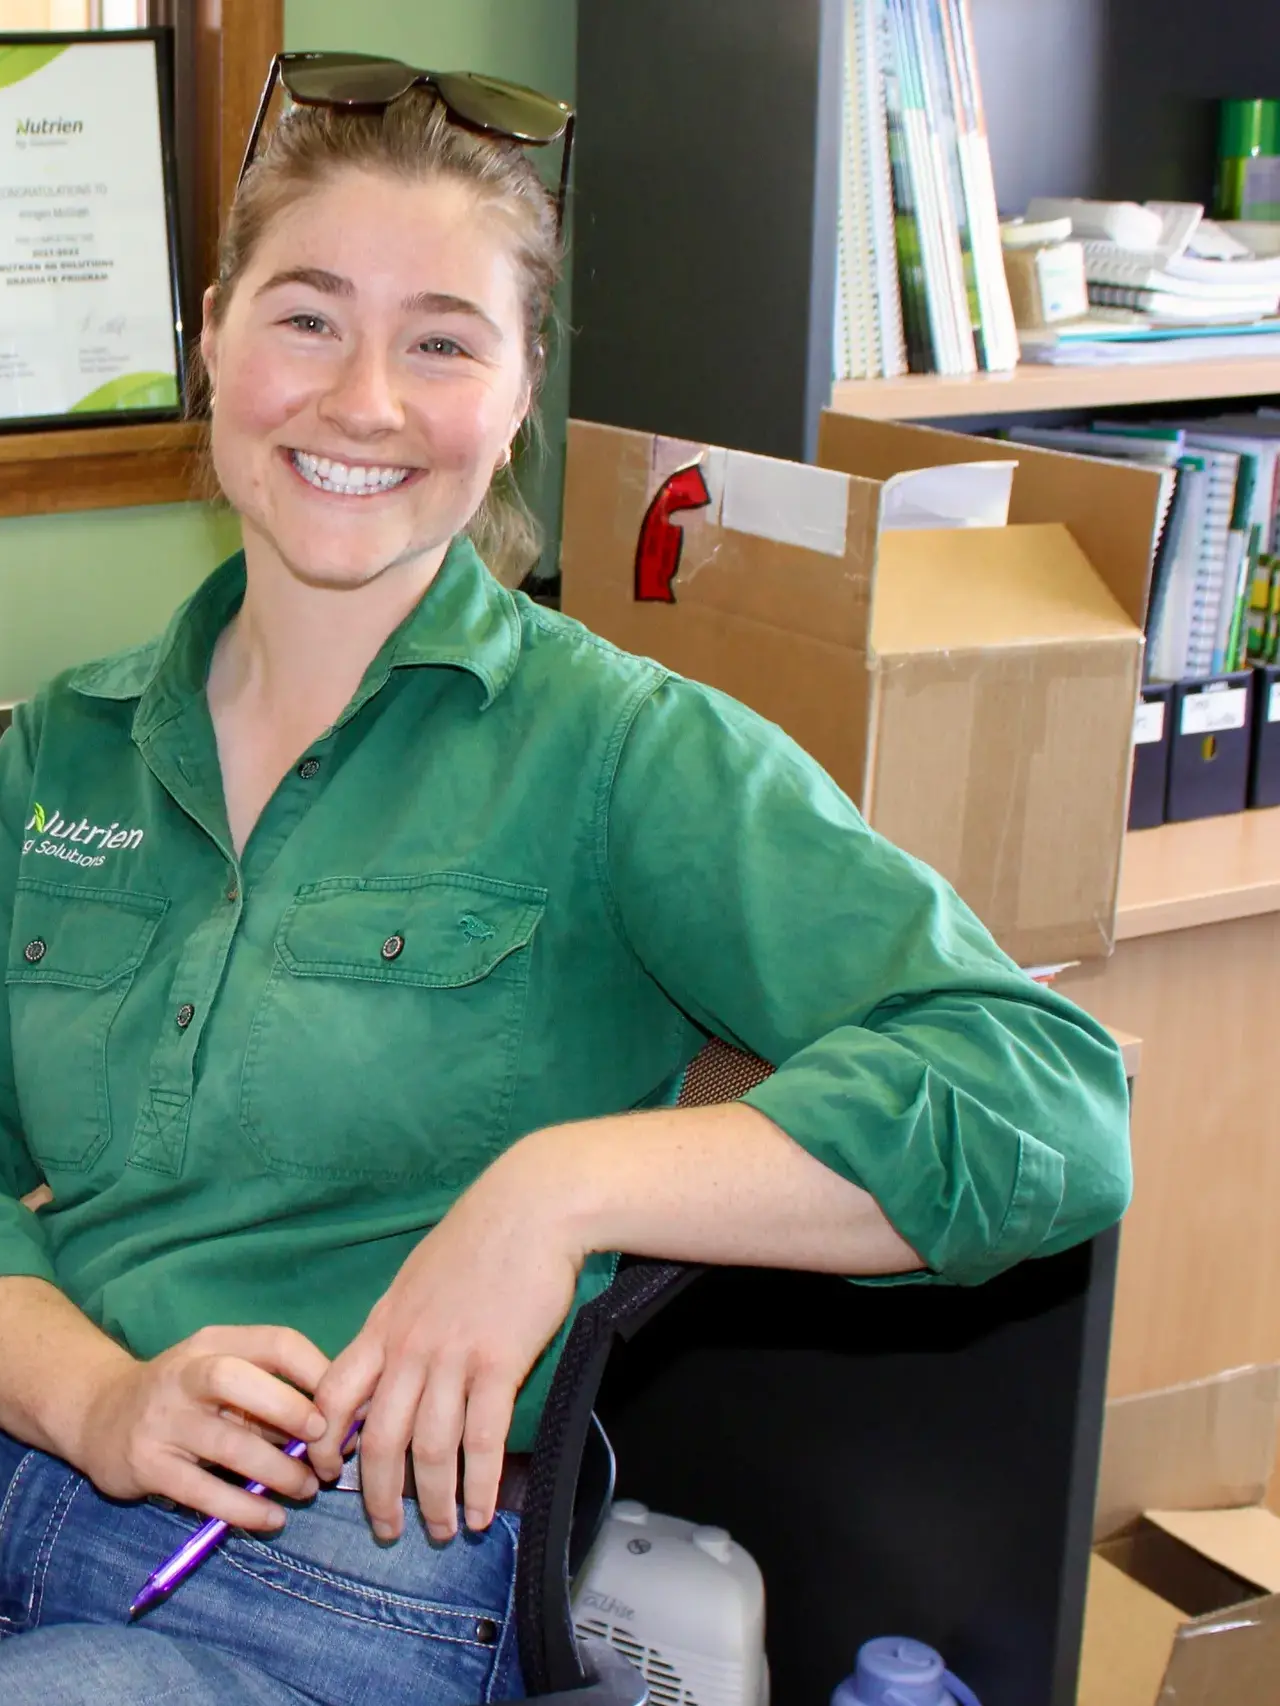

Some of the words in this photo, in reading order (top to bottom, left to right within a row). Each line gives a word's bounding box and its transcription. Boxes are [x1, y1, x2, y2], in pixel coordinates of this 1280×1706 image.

[15, 116, 84, 136] Nutrien
[59, 257, 114, 270] SOLUTIONS
[6, 275, 59, 287] GRADUATE
[60, 271, 109, 284] PROGRAM
[24, 802, 144, 849] Nutrien
[35, 839, 106, 868] Solutions
